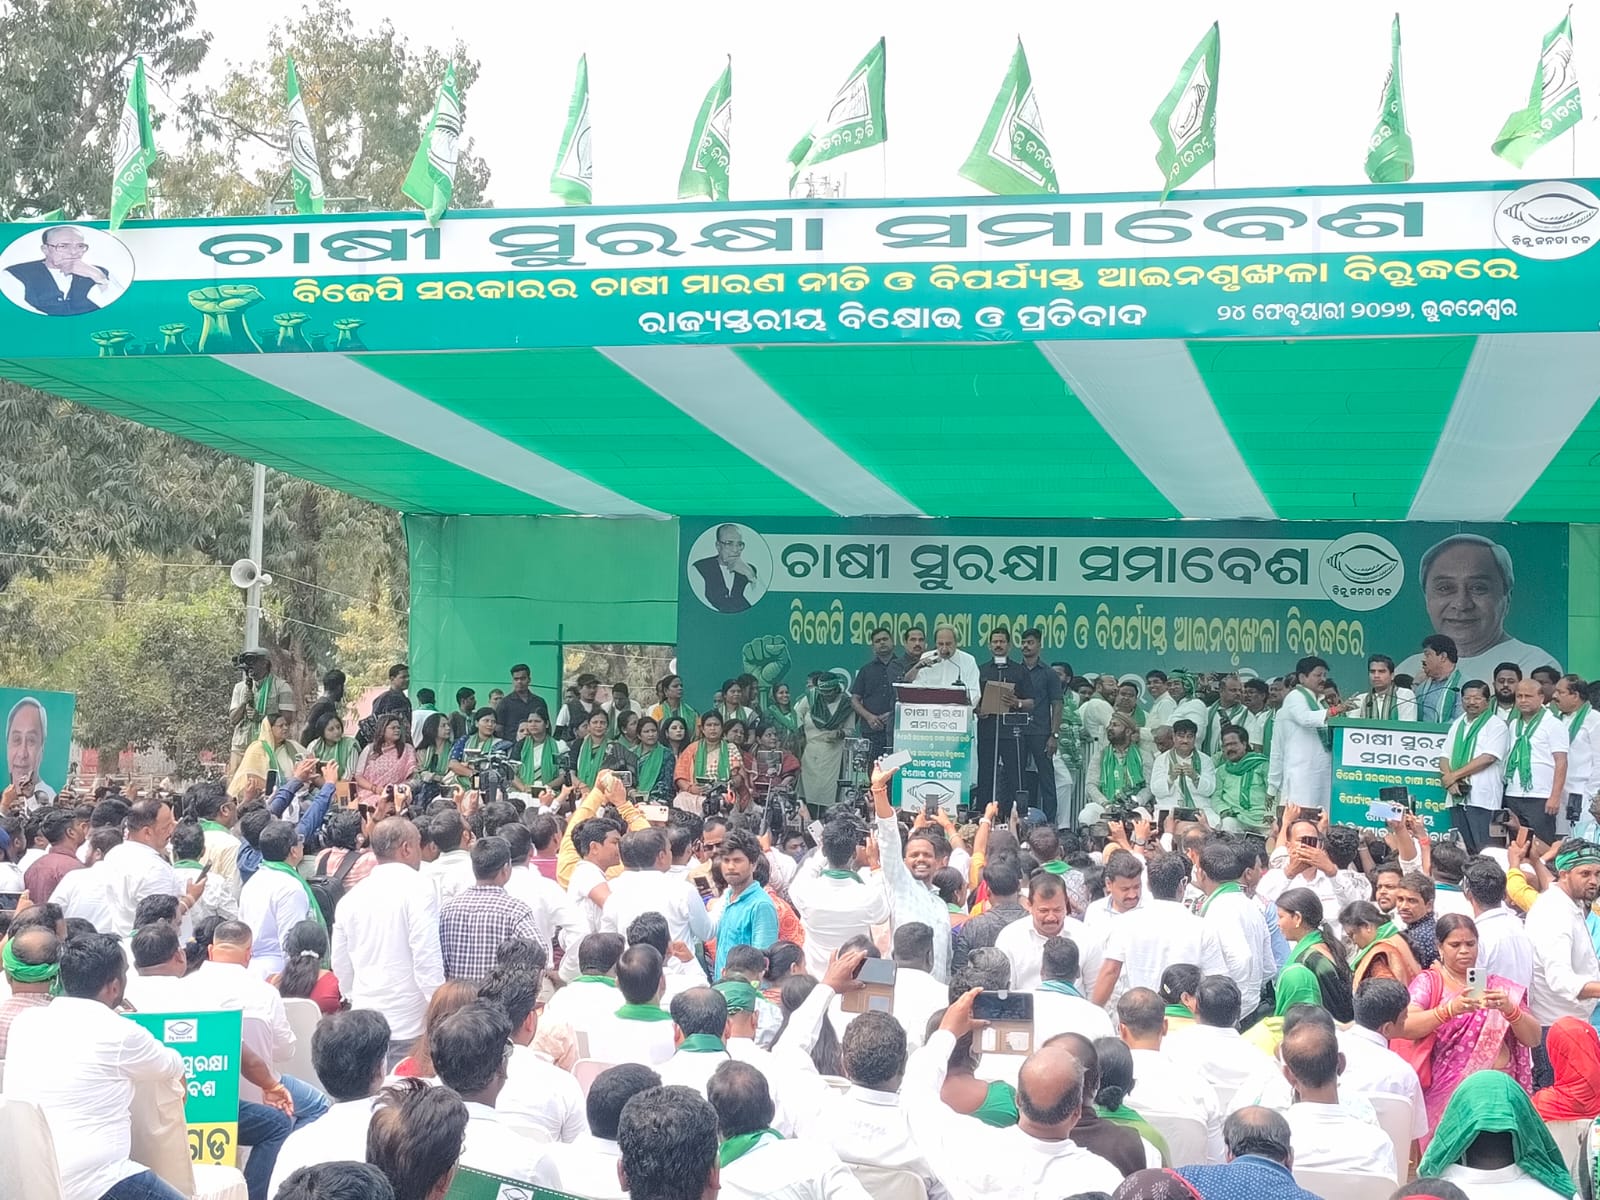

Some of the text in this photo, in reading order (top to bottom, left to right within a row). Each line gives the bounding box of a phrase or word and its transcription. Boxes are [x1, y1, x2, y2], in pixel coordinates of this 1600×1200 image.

[199, 202, 1424, 267] ଚାଷୀ ସୁରକ୍ଷା ସମାବେଶ
[1512, 235, 1591, 248] ବିଜୁ ଜନତା ଦଳ
[293, 276, 404, 303] ବିଜେପି
[416, 278, 578, 302] ସରକାରର
[591, 275, 669, 297] ଚାଷୀ
[682, 272, 785, 295] ମାରଣ
[798, 265, 870, 292] ନୀତି
[884, 271, 917, 291] ଓ
[1097, 262, 1328, 293] ଆଇନଶୃଙ୍ଖଳା
[1343, 254, 1520, 287] ବିରୁଦ୍ଧରେ
[638, 298, 1148, 334] ରାଜ୍ୟସ୍ତରୀୟ ବିକ୍ଷୋଭ ଓ ପ୍ରତିବାଦ
[1217, 305, 1246, 321] ୨୪
[781, 543, 1309, 591] ଚାଷୀ ସୁରକ୍ଷା ସମାବେଶ
[789, 598, 845, 645] ବିଜେପି
[1074, 614, 1090, 650] ଓ
[1349, 732, 1393, 746] ଚାଷୀ
